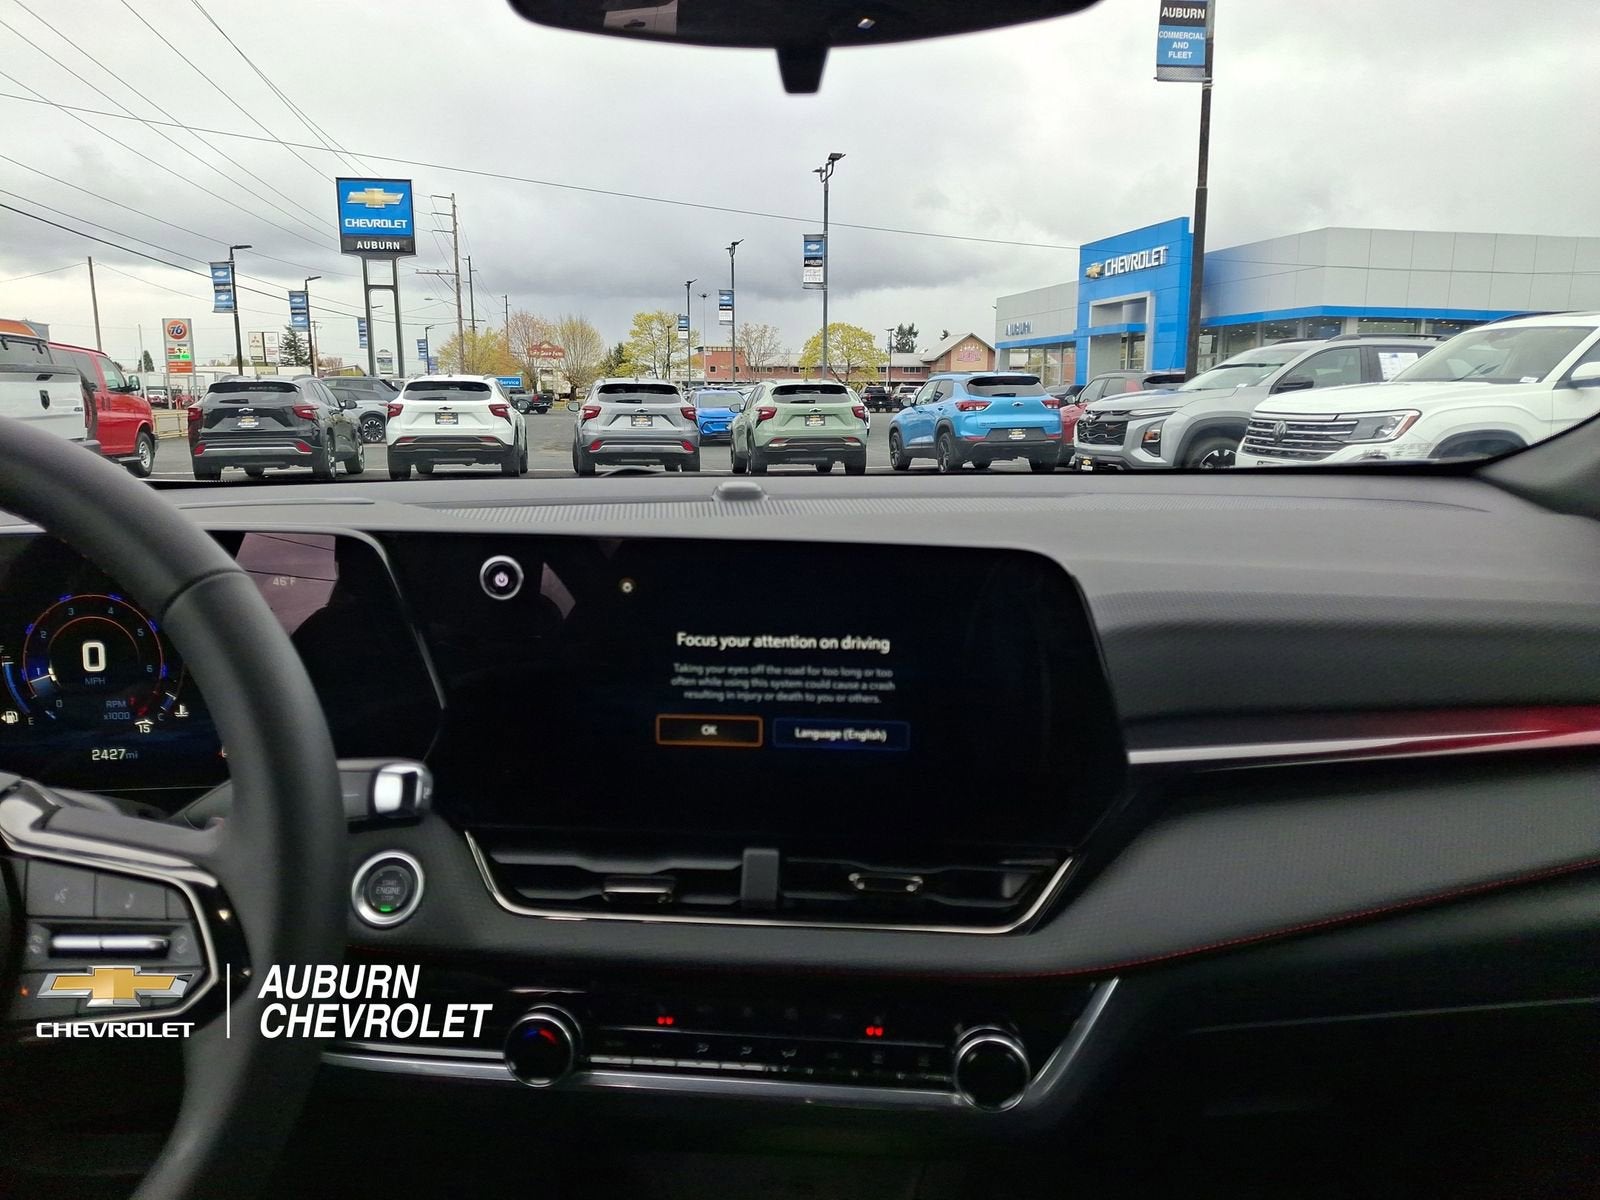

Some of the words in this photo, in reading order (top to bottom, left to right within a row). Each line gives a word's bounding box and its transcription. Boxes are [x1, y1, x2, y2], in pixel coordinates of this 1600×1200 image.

[1162, 6, 1206, 19] AUBURN
[1158, 30, 1205, 40] COMMERCIAL
[1168, 51, 1192, 59] FLEET
[344, 218, 408, 229] CHEVROLET
[356, 240, 400, 250] AUBURN
[1104, 246, 1167, 277] CHEVROLET
[170, 325, 183, 335] 76
[68, 608, 74, 616] 3
[107, 606, 114, 615] 4
[40, 630, 47, 639] 2
[138, 628, 144, 637] 5
[676, 632, 718, 647] Focus
[720, 636, 752, 651] your
[753, 635, 817, 650] attention
[818, 638, 839, 650] on
[840, 634, 890, 654] driving
[82, 641, 106, 673] 0
[146, 664, 153, 673] 6
[673, 663, 704, 676] Taking
[706, 666, 726, 676] your
[728, 666, 749, 676] eyes
[750, 664, 765, 674] off
[766, 665, 782, 675] the
[784, 666, 805, 676] road
[806, 666, 821, 676] for
[822, 667, 840, 676] too
[840, 666, 862, 679] long
[864, 669, 874, 678] or
[876, 668, 894, 678] too
[84, 677, 105, 685] MPH
[671, 677, 697, 686] often
[698, 677, 723, 687] while
[724, 679, 749, 690] using
[750, 678, 768, 688] this
[770, 680, 803, 690] system
[804, 680, 831, 690] could
[832, 682, 860, 690] cause
[862, 682, 868, 690] a
[869, 680, 896, 691] crash
[684, 690, 724, 702] resulting
[726, 691, 736, 700] in
[736, 691, 762, 702] injury
[764, 692, 774, 700] or
[776, 691, 802, 702] death
[804, 693, 816, 702] to
[816, 694, 835, 704] you
[836, 694, 846, 702] or
[106, 700, 126, 708] RPM
[104, 712, 130, 720] x1000
[28, 717, 34, 726] E
[138, 724, 150, 734] 15
[701, 724, 718, 736] OK
[794, 727, 842, 741] Language
[844, 728, 887, 742] (English)
[376, 886, 400, 894] ENGINE
